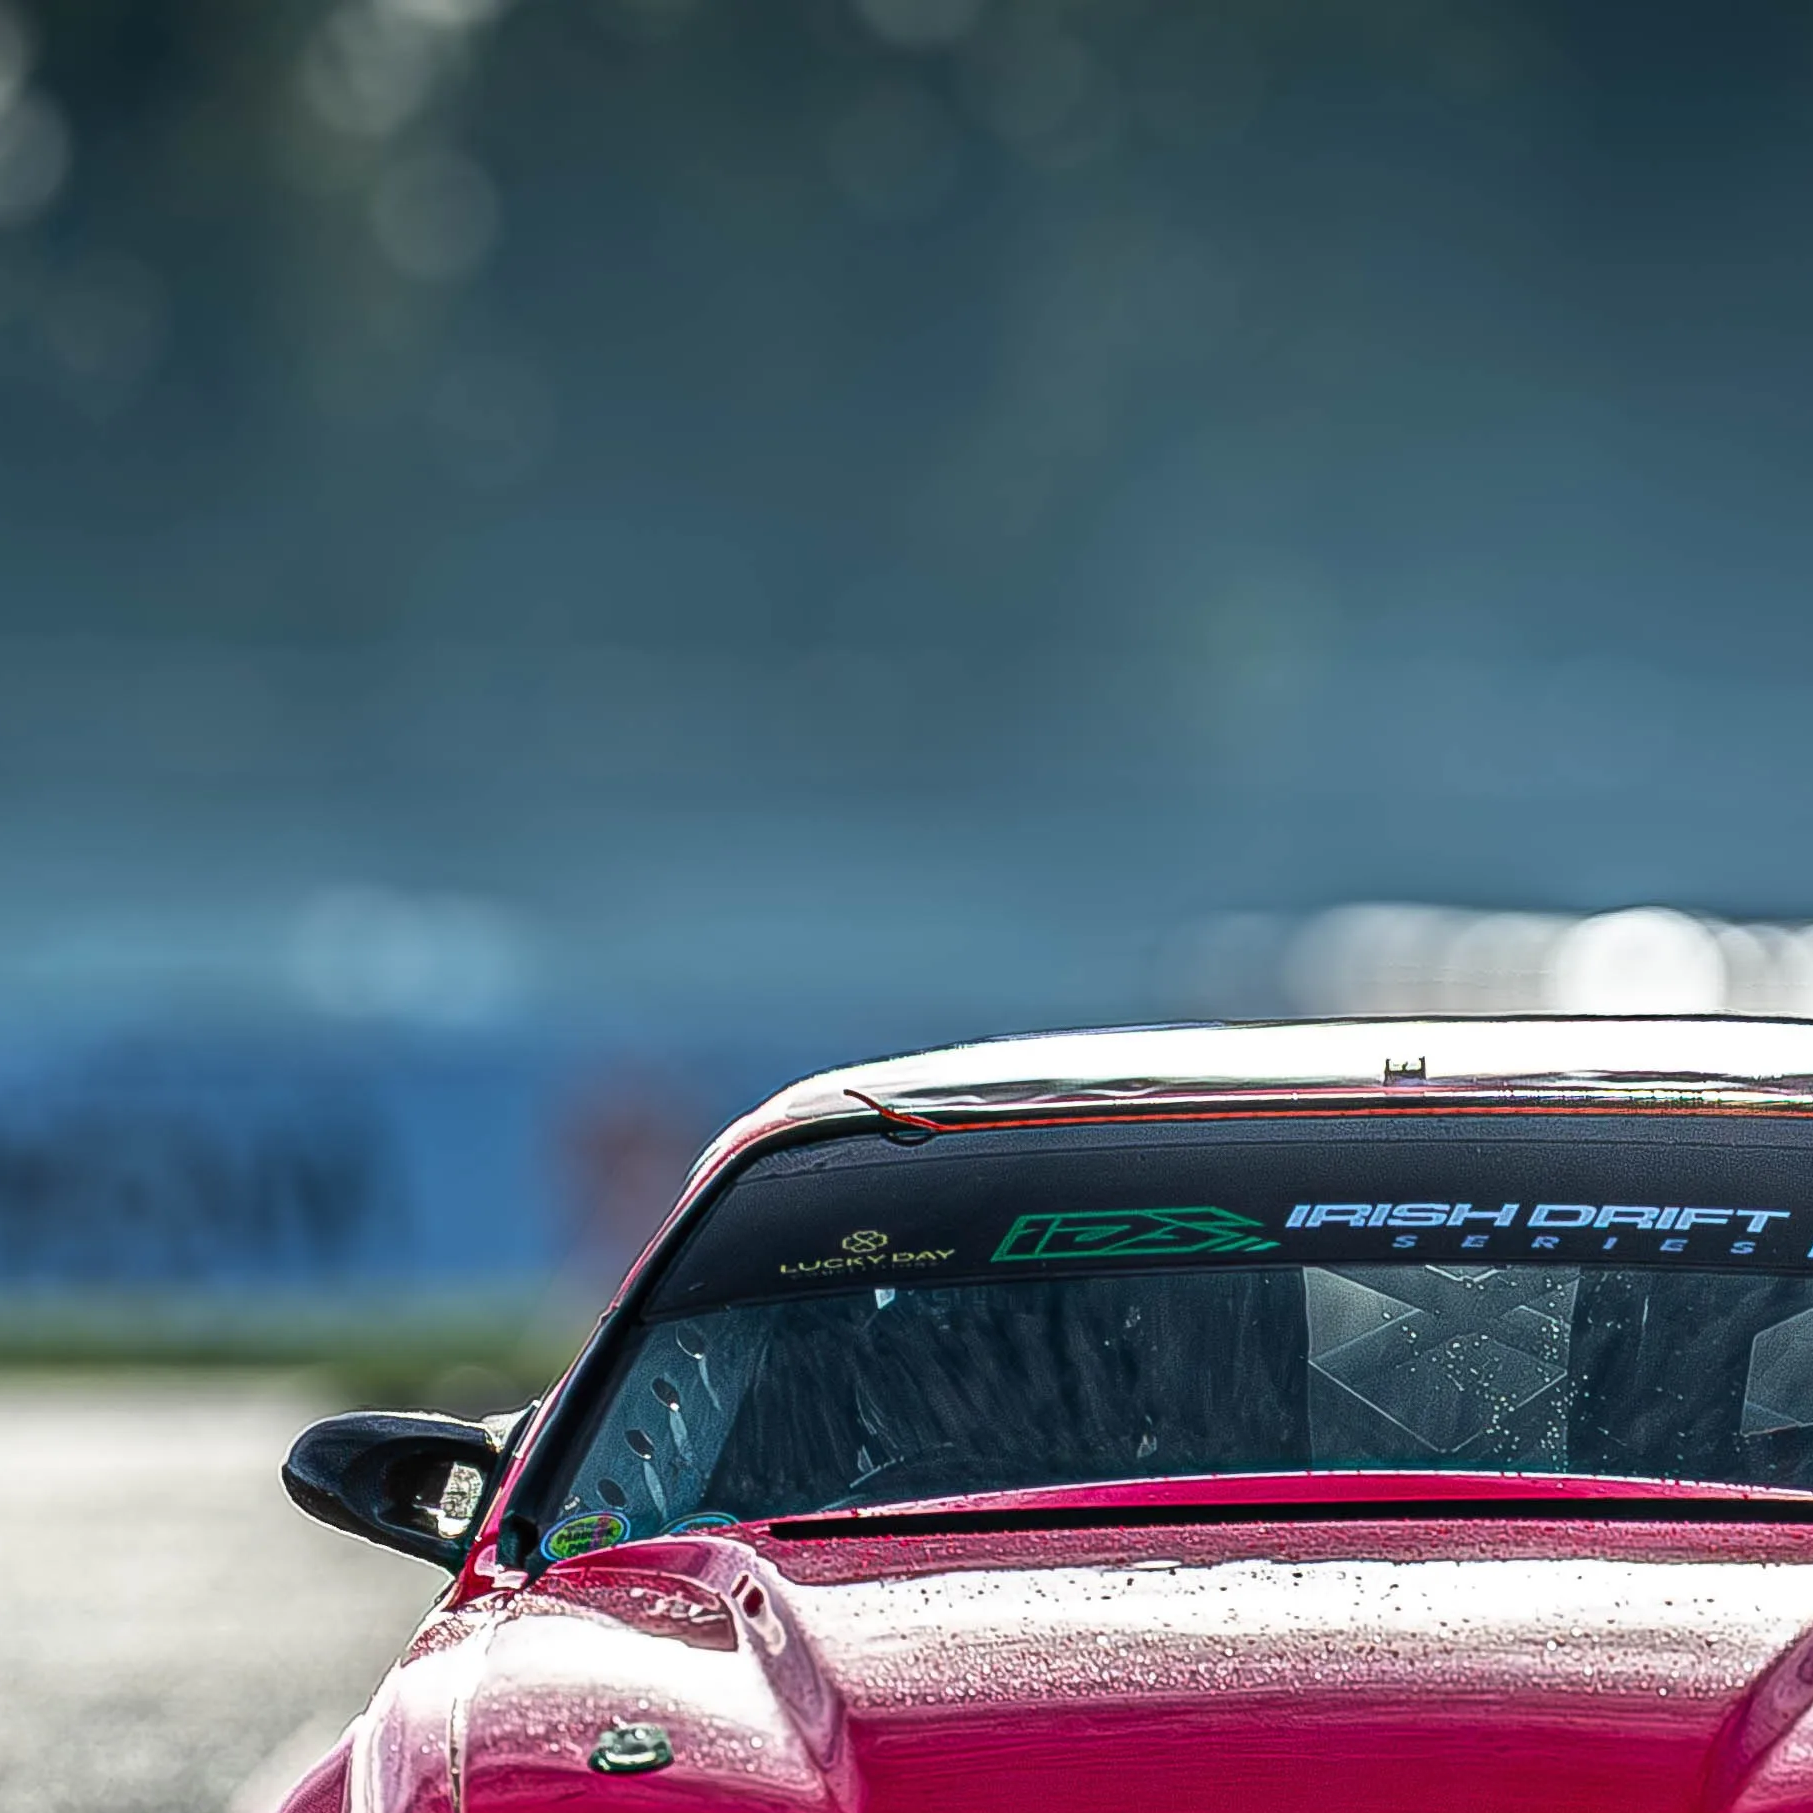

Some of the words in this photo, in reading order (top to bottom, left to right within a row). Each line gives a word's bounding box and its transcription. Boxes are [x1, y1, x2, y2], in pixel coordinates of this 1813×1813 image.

[1285, 1203, 1520, 1228] IRISH
[1526, 1203, 1791, 1233] DRIFT
[1391, 1234, 1757, 1255] SERIES
[780, 1253, 886, 1273] LUCKY
[892, 1248, 956, 1263] DAY
